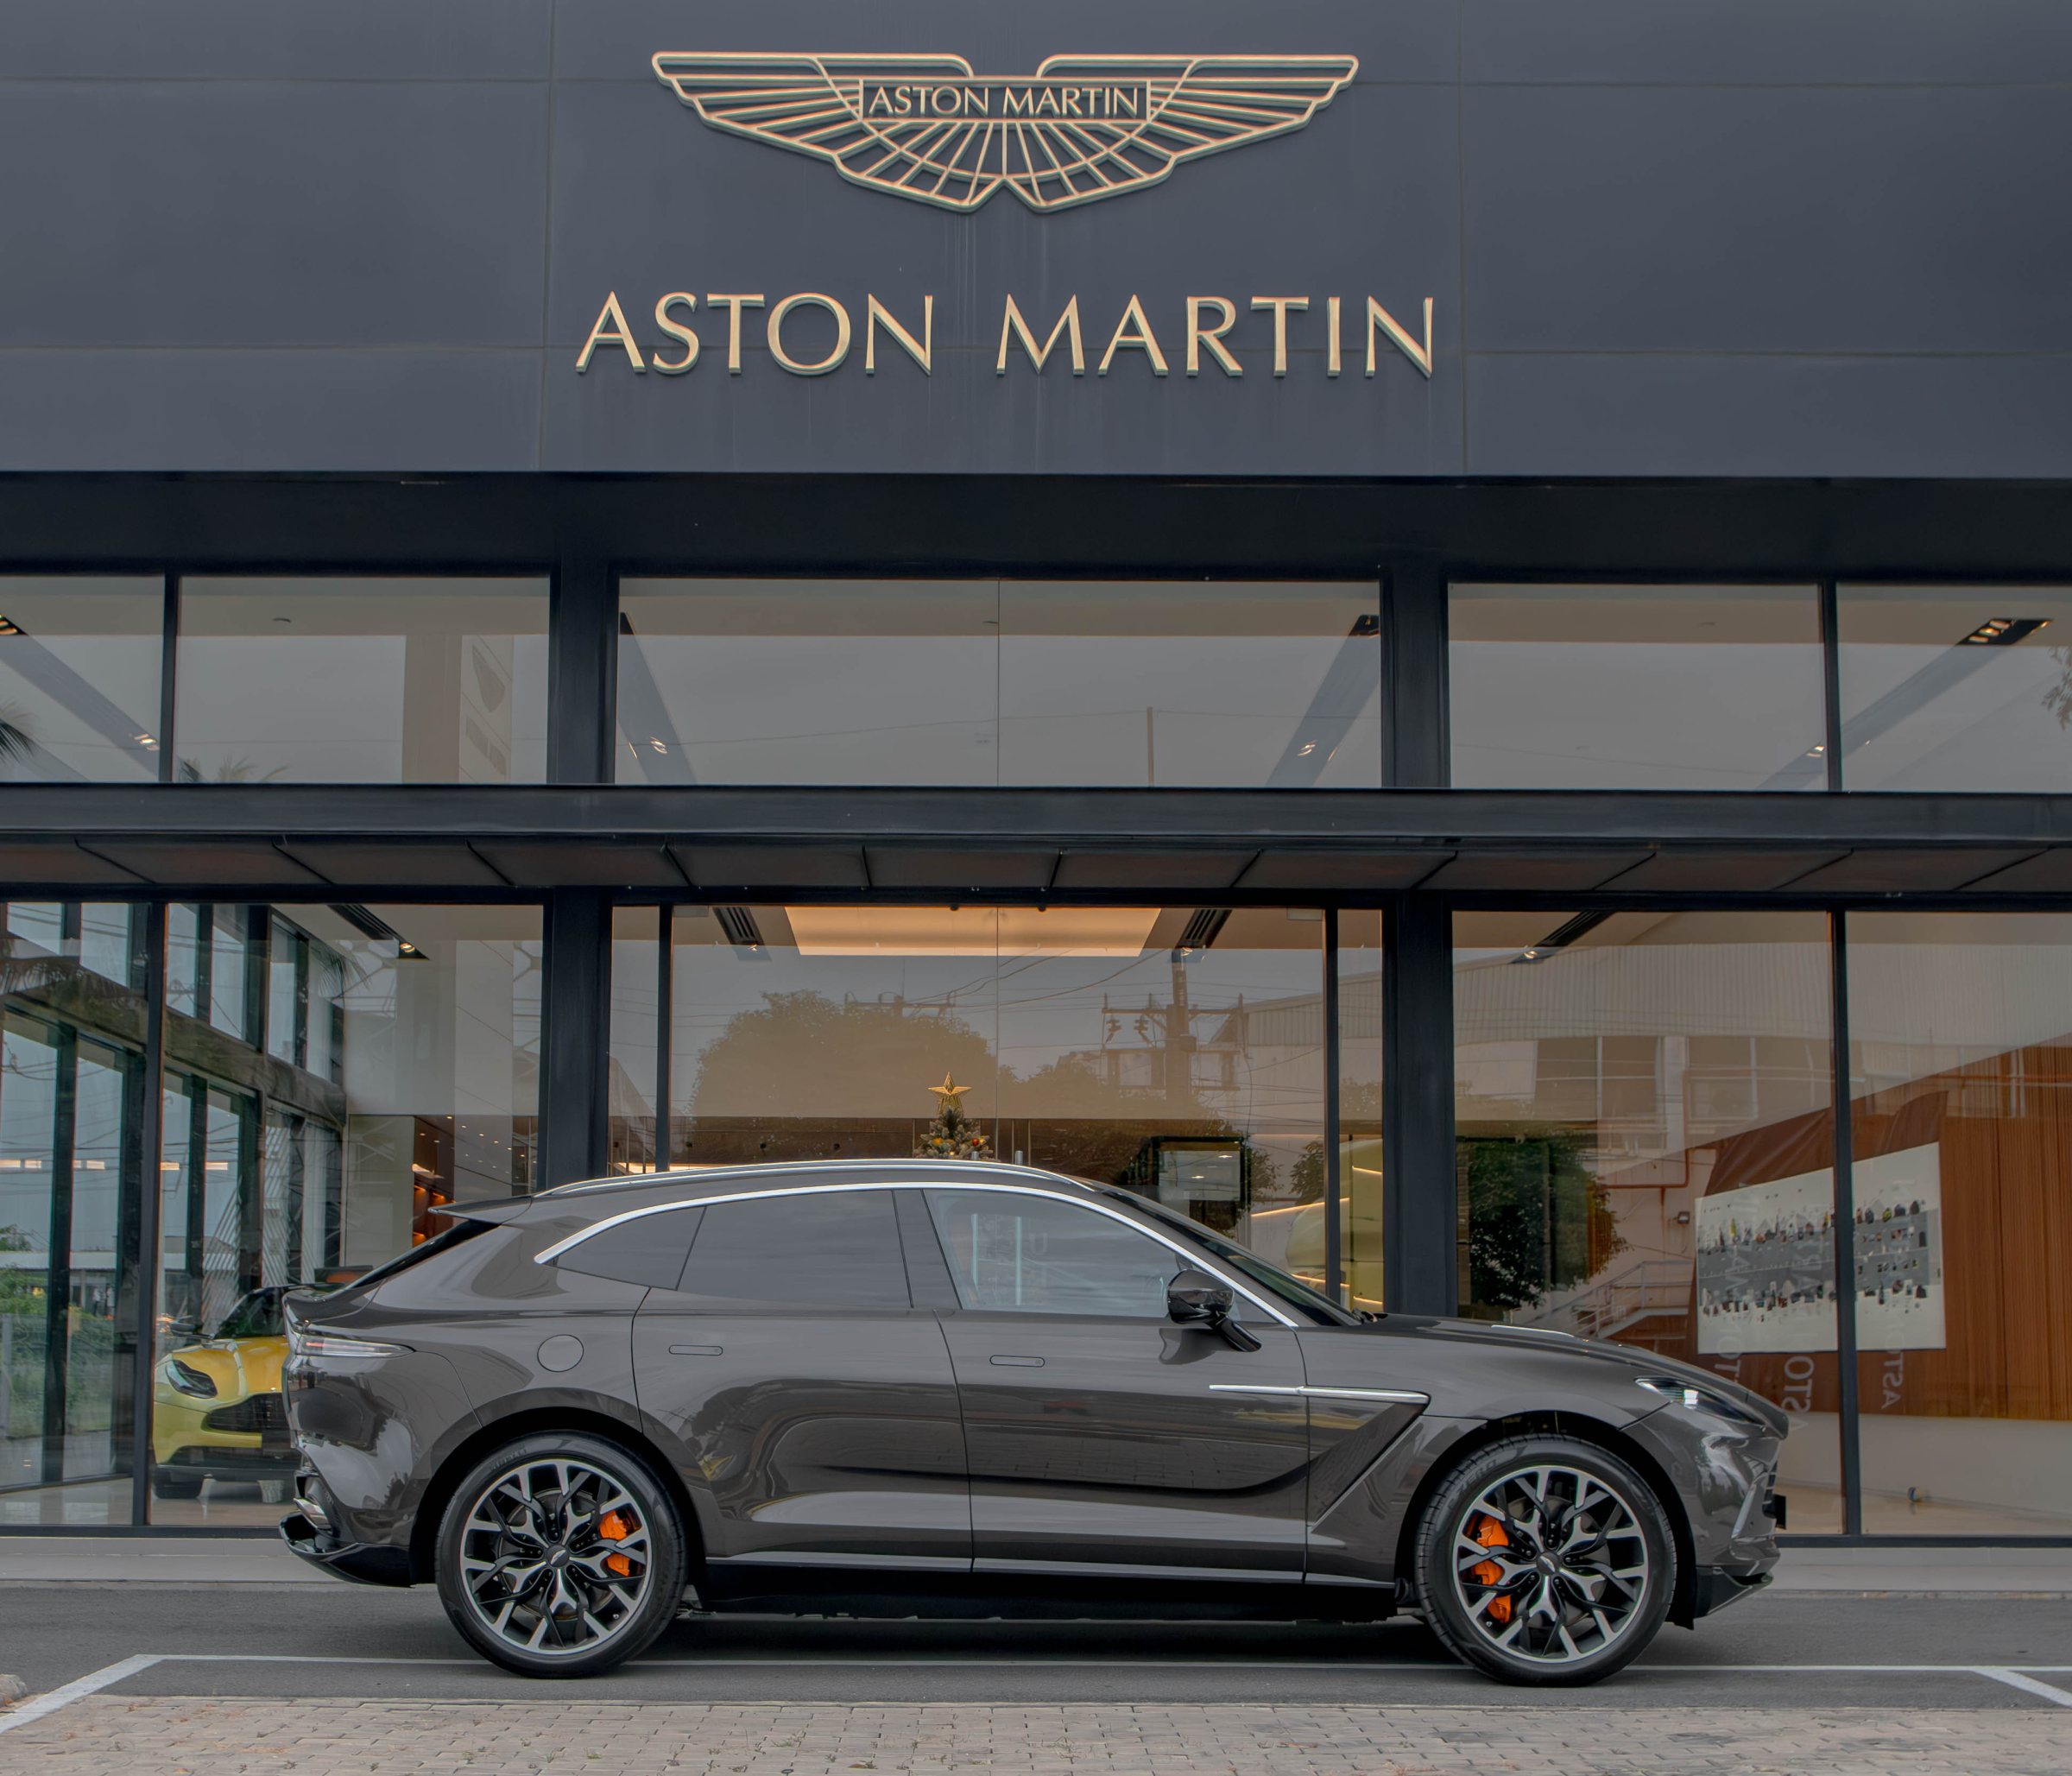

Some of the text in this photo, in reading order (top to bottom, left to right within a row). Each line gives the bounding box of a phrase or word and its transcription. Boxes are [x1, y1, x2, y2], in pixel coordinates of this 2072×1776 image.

[869, 85, 1139, 119] ASTON MARTIN
[575, 290, 1434, 379] ASTON MARTIN
